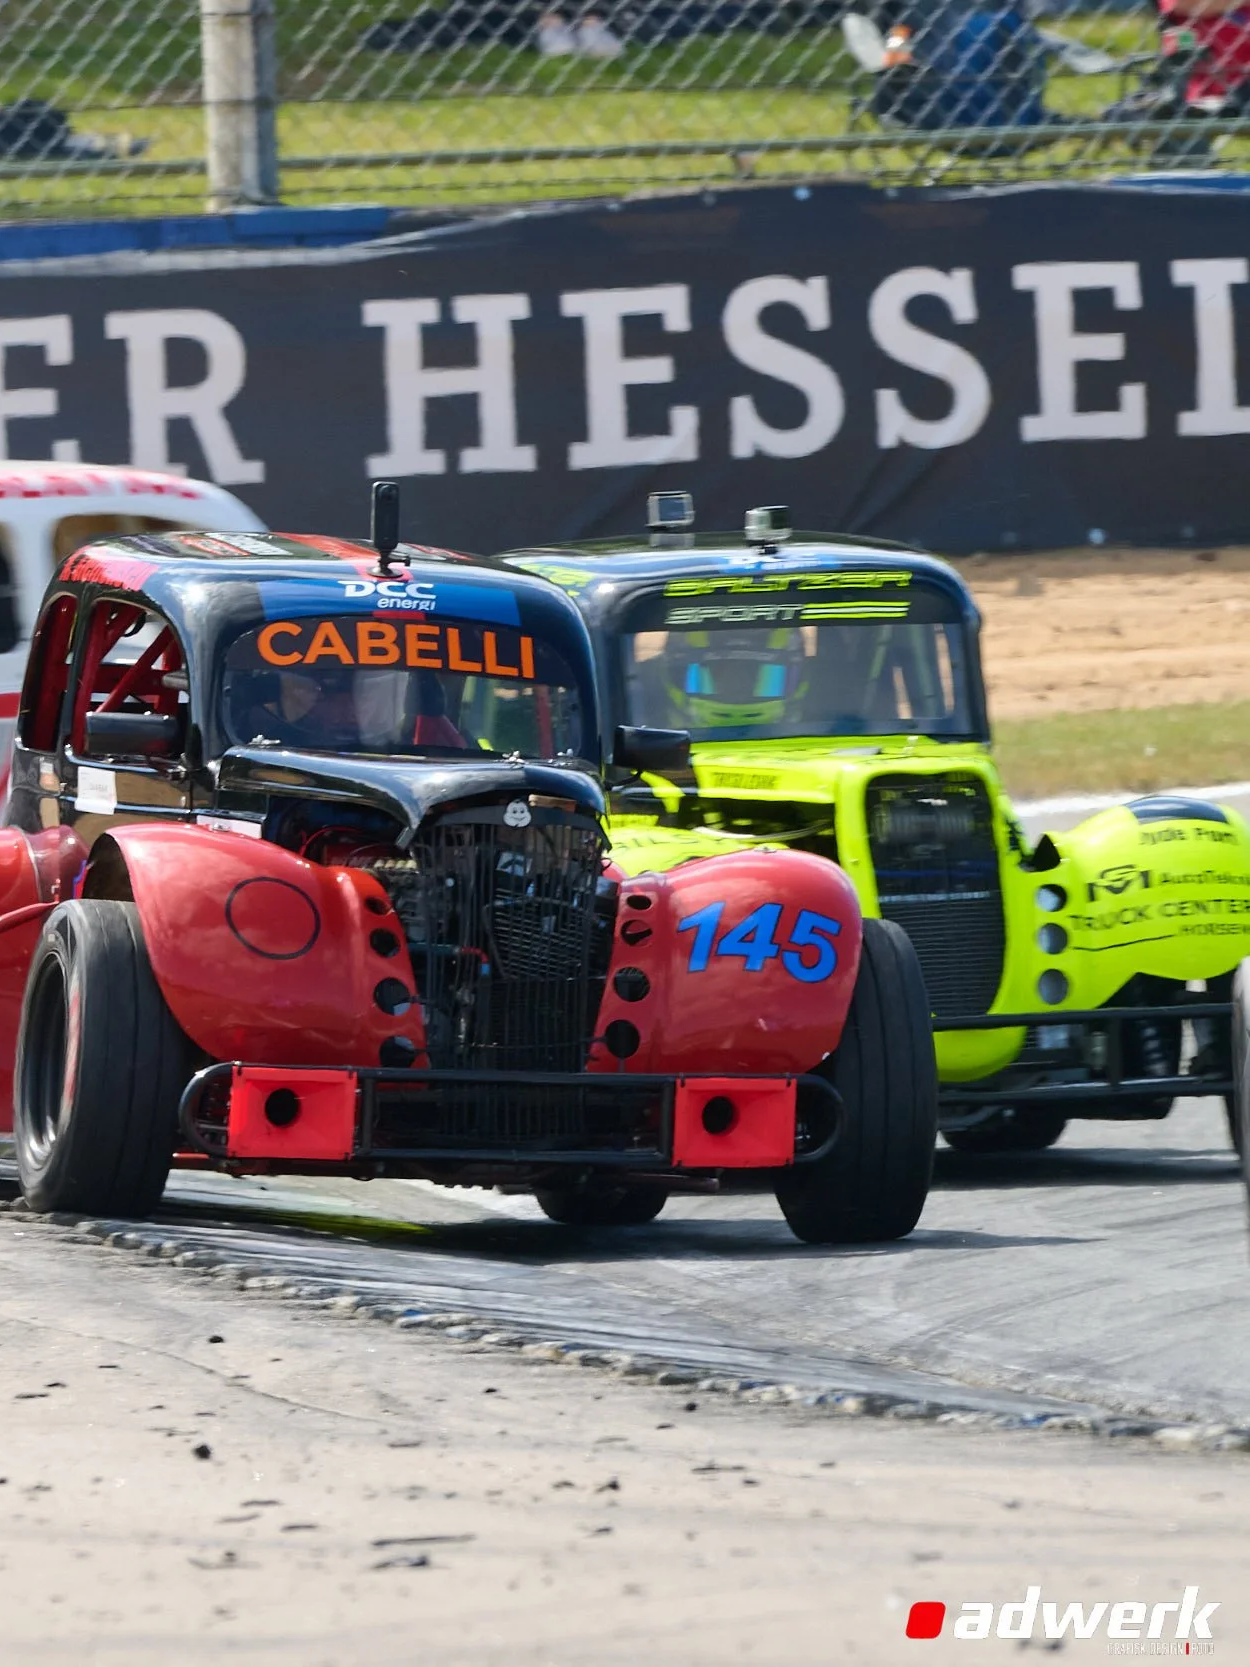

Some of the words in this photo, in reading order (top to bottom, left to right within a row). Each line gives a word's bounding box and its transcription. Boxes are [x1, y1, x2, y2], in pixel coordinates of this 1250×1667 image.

[337, 580, 437, 599] DCC
[377, 598, 437, 610] energi
[664, 604, 804, 625] SPORT
[257, 621, 535, 679] CABELLI
[1067, 904, 1152, 931] TRUCK
[677, 901, 842, 984] 145
